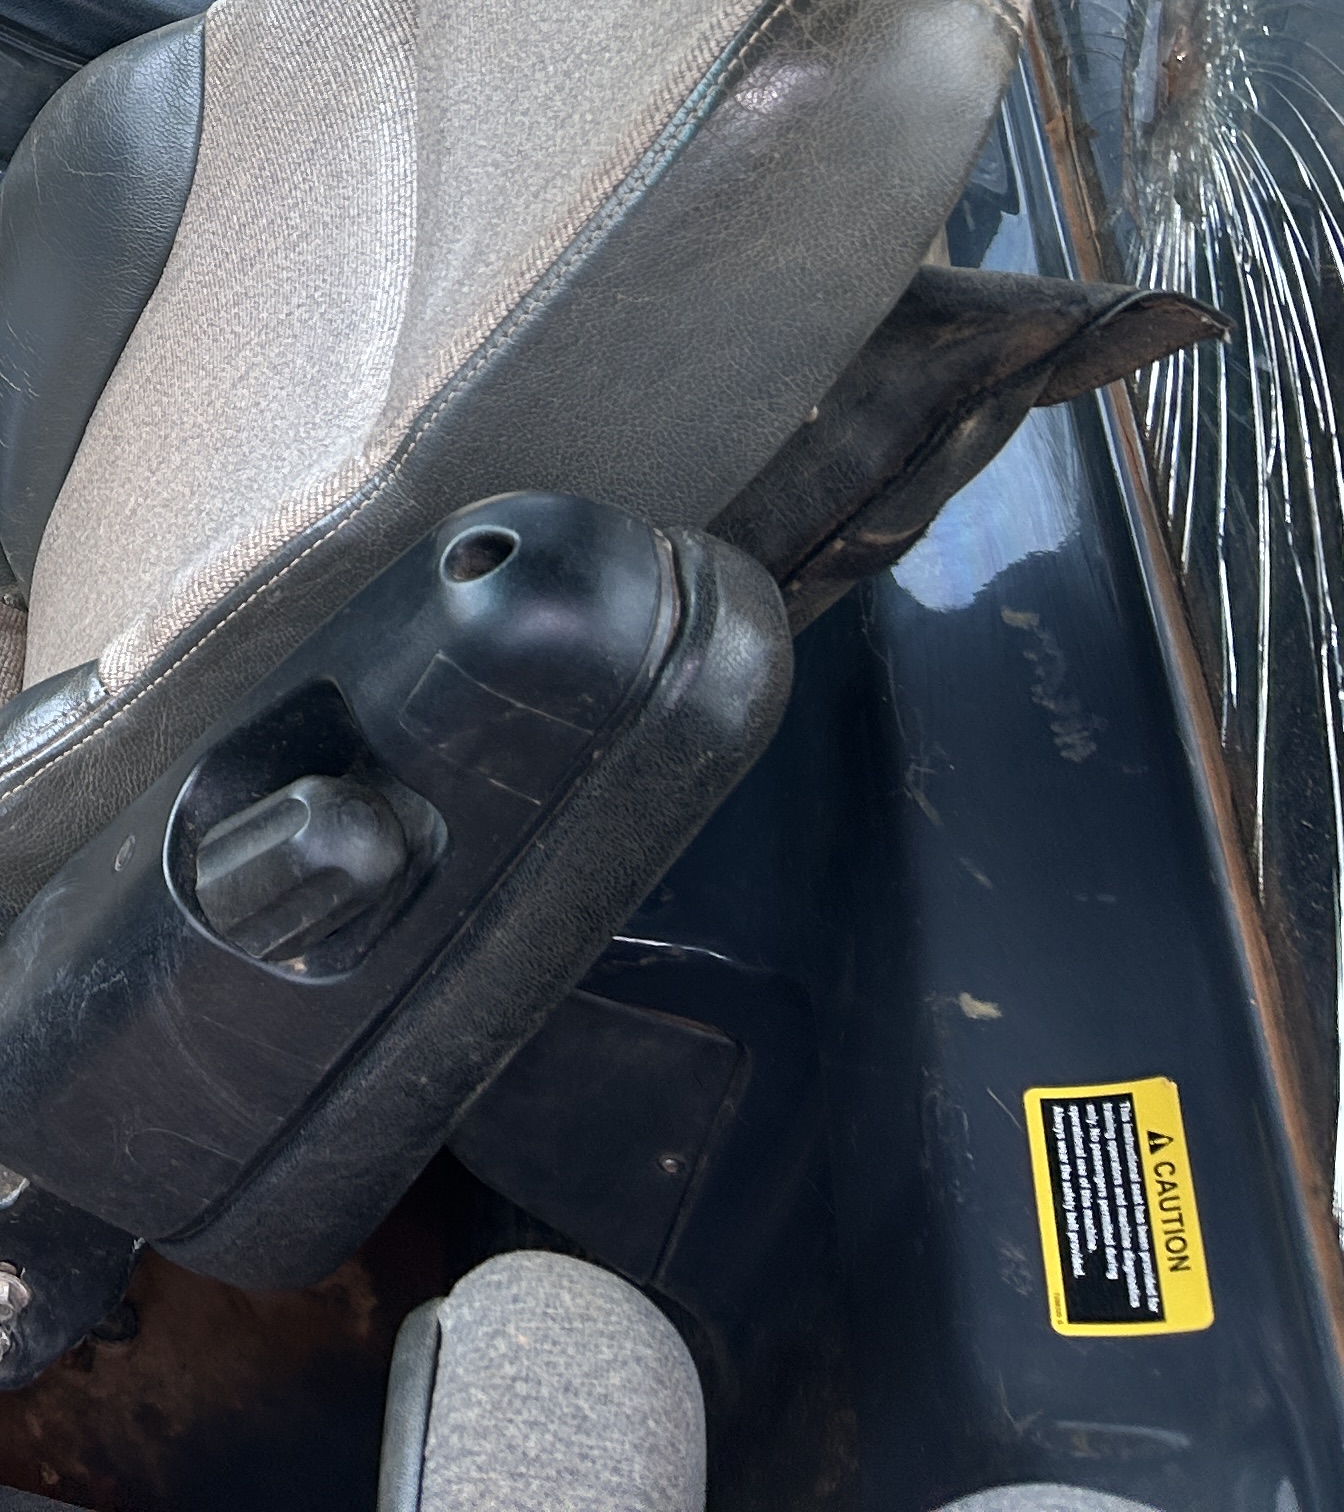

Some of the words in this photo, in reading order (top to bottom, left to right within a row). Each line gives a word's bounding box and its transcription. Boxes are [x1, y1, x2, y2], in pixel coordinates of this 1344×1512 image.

[1051, 1105, 1066, 1139] Always
[1101, 1103, 1116, 1138] training
[1119, 1101, 1131, 1121] This
[1068, 1105, 1085, 1156] operational
[1087, 1128, 1099, 1141] No
[1055, 1139, 1069, 1162] wear
[1106, 1140, 1122, 1184] operators
[1123, 1123, 1139, 1181] instructional
[1058, 1164, 1071, 1180] the
[1075, 1158, 1087, 1175] use
[1090, 1142, 1106, 1197] passengers
[1060, 1181, 1075, 1210] safety
[1077, 1177, 1089, 1188] of
[1113, 1186, 1125, 1205] and
[1131, 1183, 1143, 1204] seat
[1079, 1188, 1092, 1207] this
[1064, 1211, 1078, 1231] belt
[1097, 1198, 1113, 1245] permitted
[1115, 1206, 1131, 1248] machine
[1134, 1205, 1146, 1224] has
[1154, 1161, 1189, 1272] CAUTION
[1137, 1225, 1149, 1249] been
[1103, 1246, 1118, 1279] during
[1140, 1251, 1156, 1295] provided
[1121, 1250, 1139, 1307] diagnostics
[1147, 1296, 1158, 1312] for
